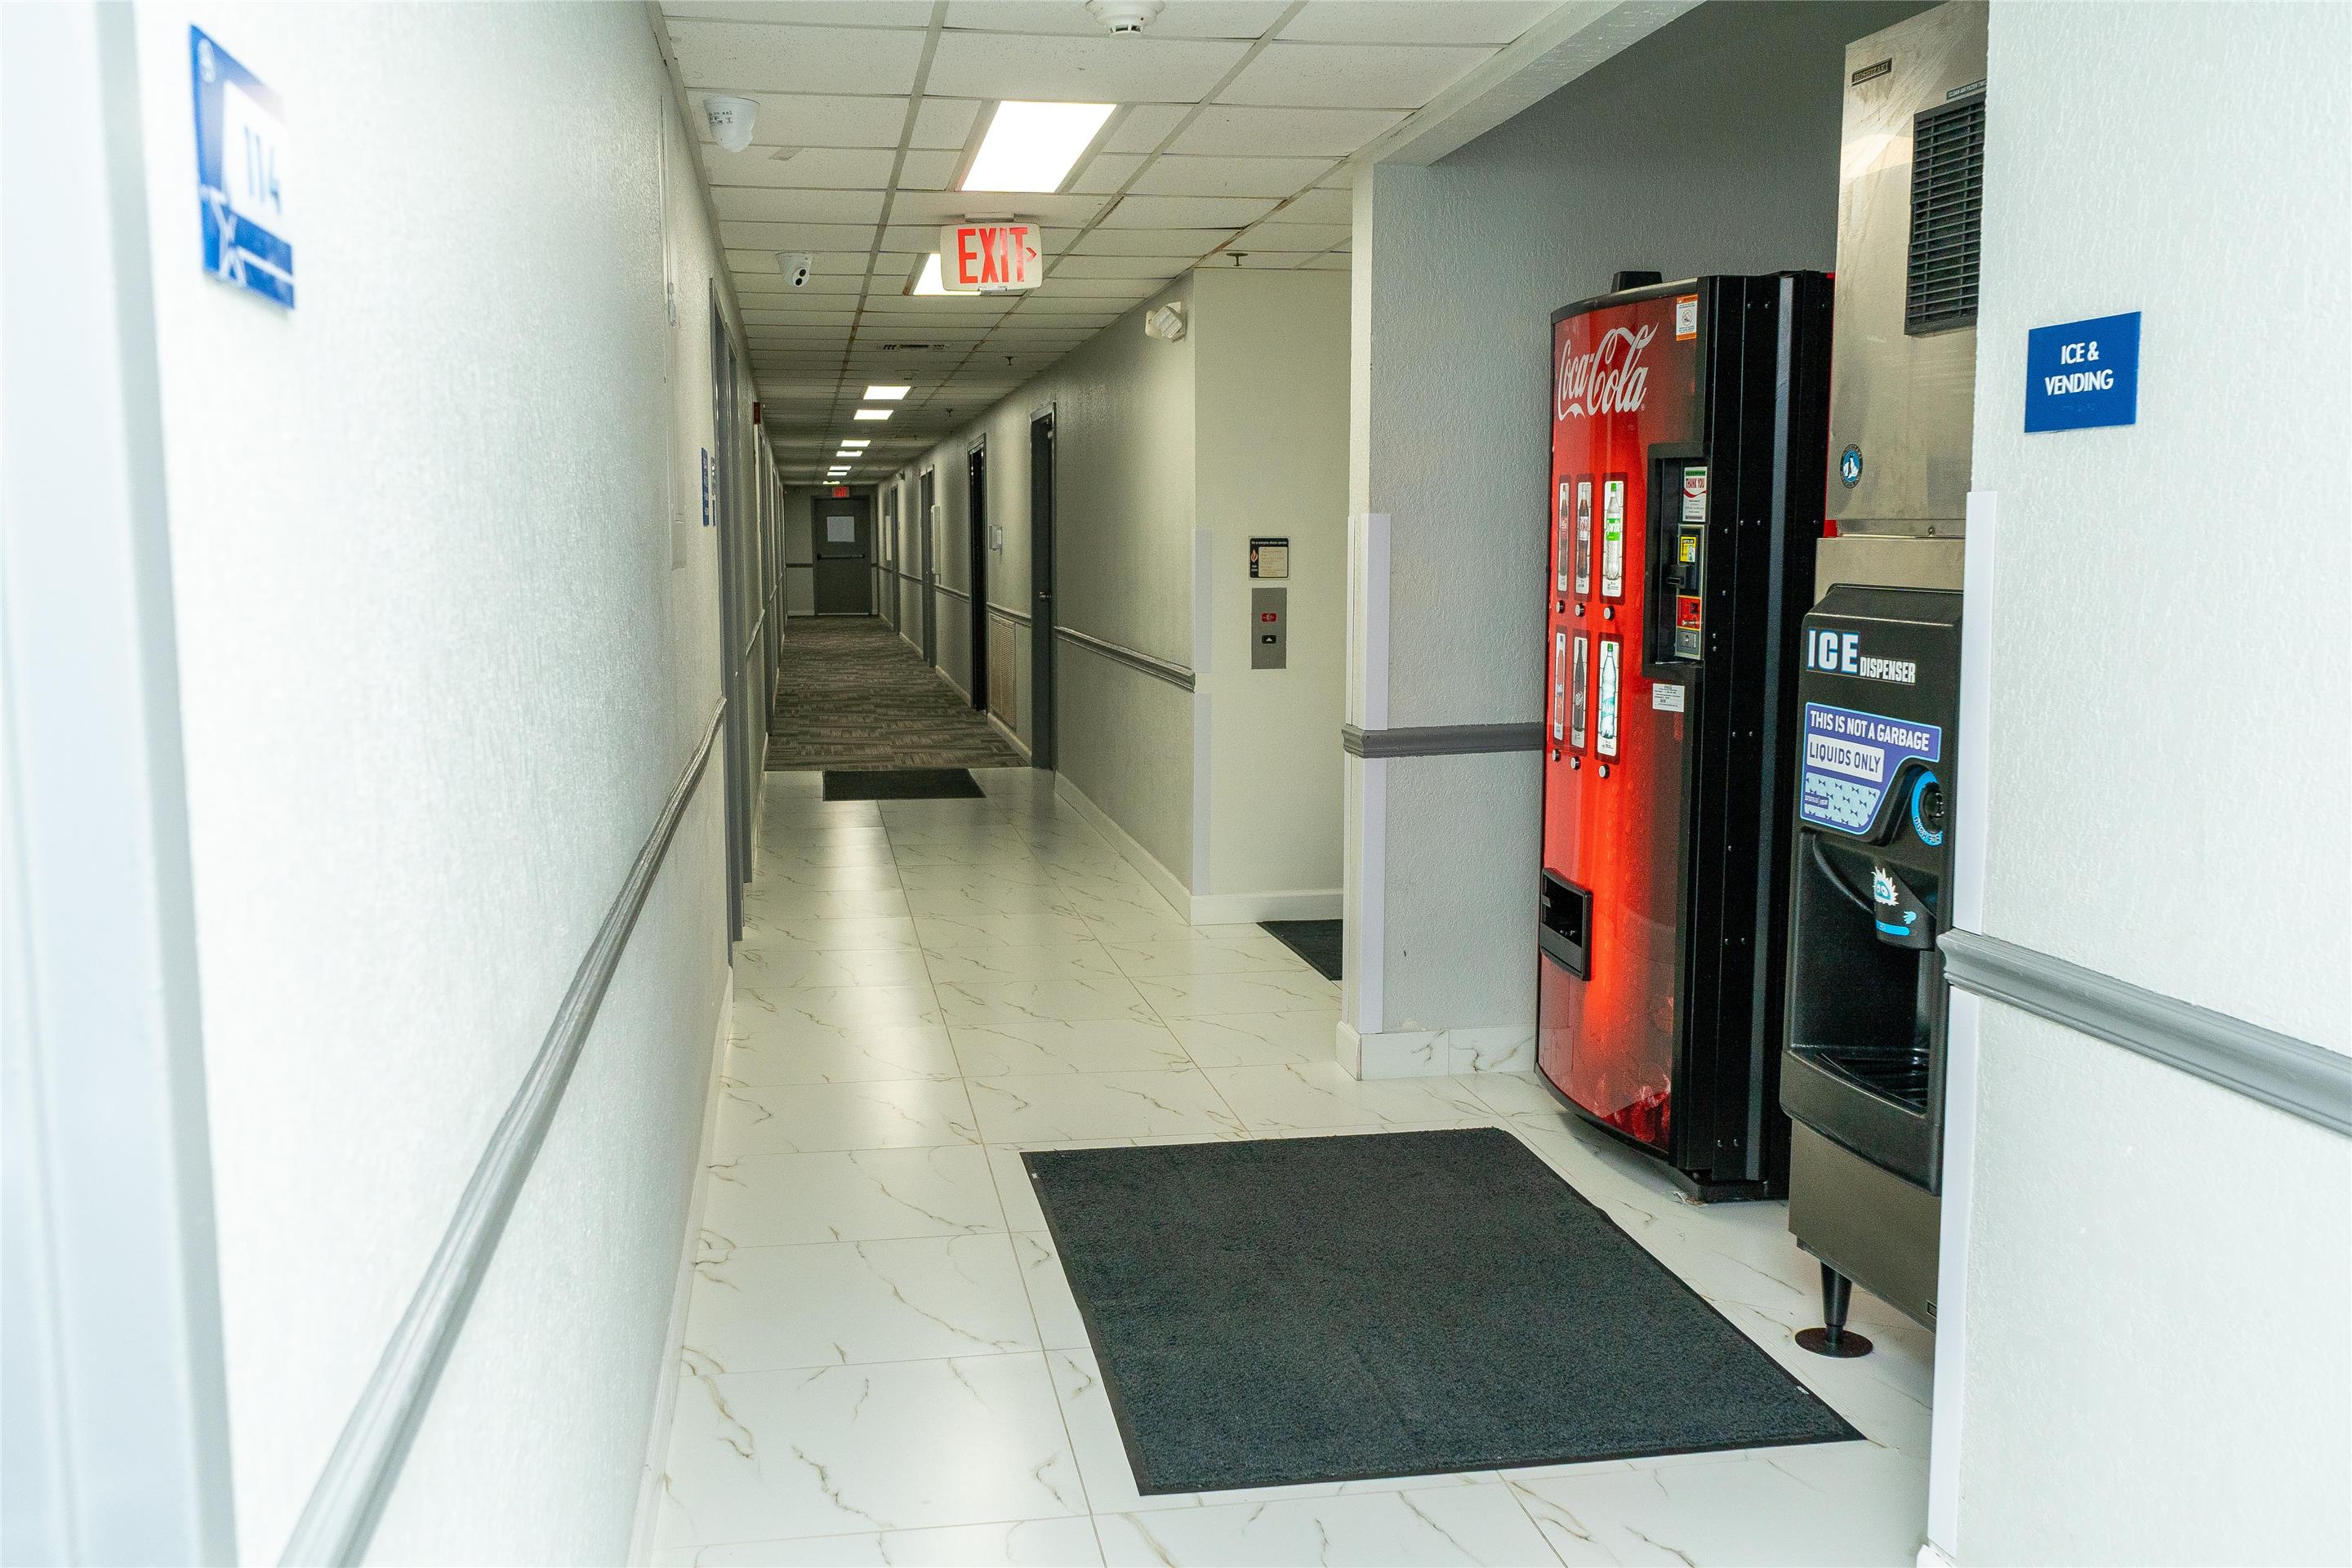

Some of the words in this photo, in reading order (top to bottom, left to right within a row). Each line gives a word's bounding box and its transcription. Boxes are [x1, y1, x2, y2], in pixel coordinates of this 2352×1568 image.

[957, 227, 1028, 283] EXIT
[2060, 342, 2085, 365] ICE
[2087, 341, 2100, 361] &
[1558, 322, 1659, 421] Coca-Cola
[2044, 368, 2114, 396] VENDING
[1686, 478, 1697, 488] THANK
[1807, 630, 1859, 673] ICE
[1860, 657, 1916, 683] DISPENSER
[1810, 710, 1833, 731] THIS
[1835, 715, 1846, 733] IS
[1846, 718, 1868, 738] NOT
[1868, 722, 1875, 741] A
[1877, 724, 1931, 751] GARBAGE
[1810, 742, 1851, 767] LIQUIDS
[1854, 751, 1881, 773] ONLY
